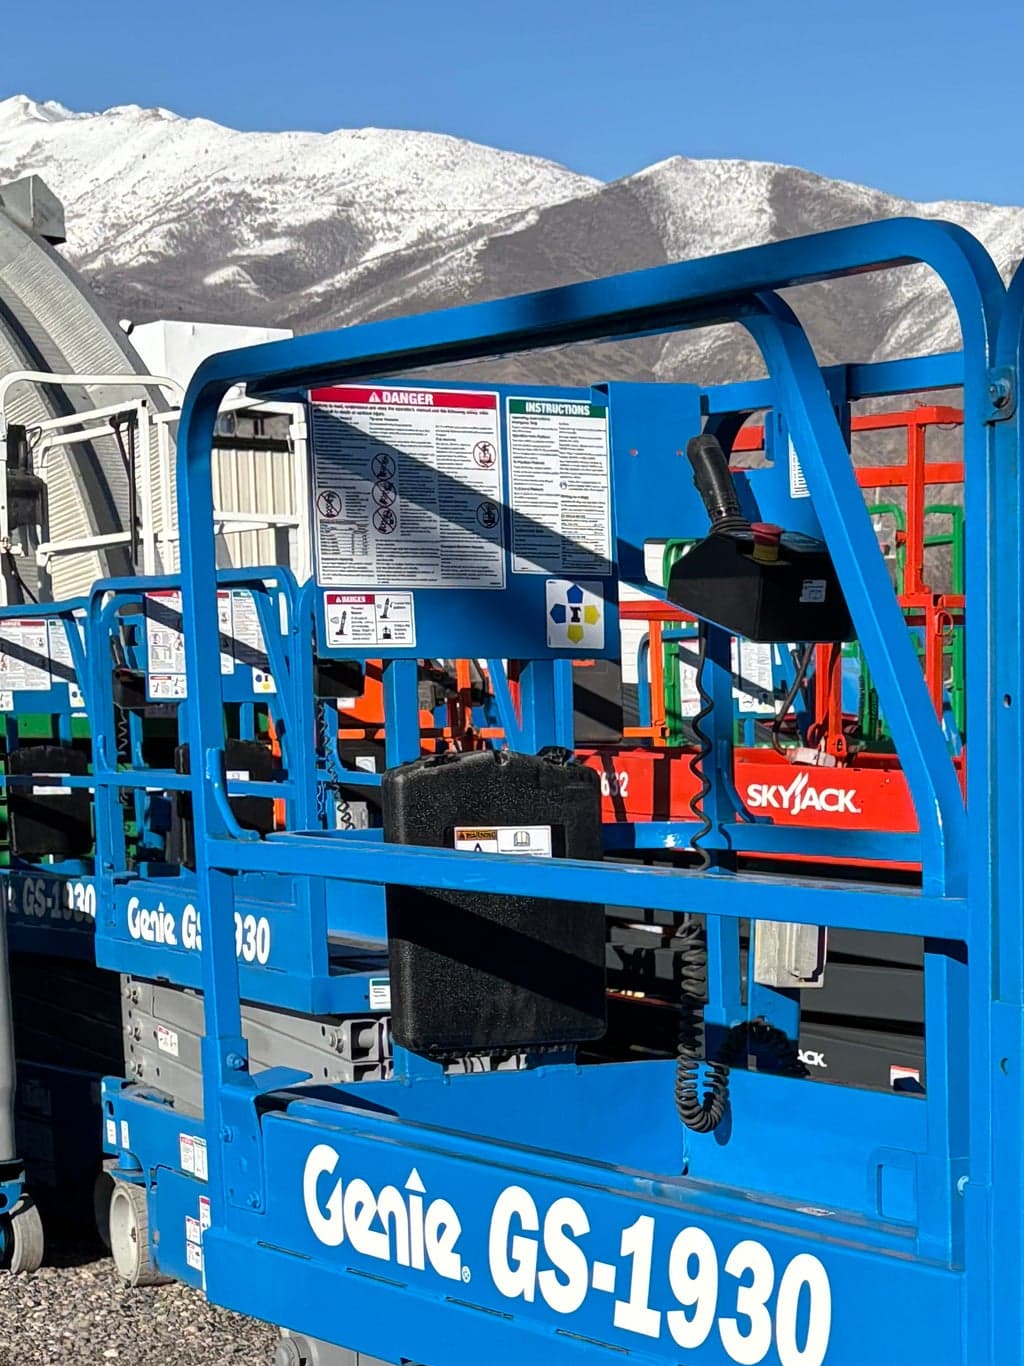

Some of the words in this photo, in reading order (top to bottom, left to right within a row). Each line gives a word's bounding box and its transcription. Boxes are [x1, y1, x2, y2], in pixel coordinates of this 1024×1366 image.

[382, 391, 434, 406] DANGER
[526, 402, 590, 416] INSTRUCTIONS
[747, 771, 858, 815] SKYJACK
[128, 897, 177, 945] Genie
[303, 1143, 462, 1282] Genie
